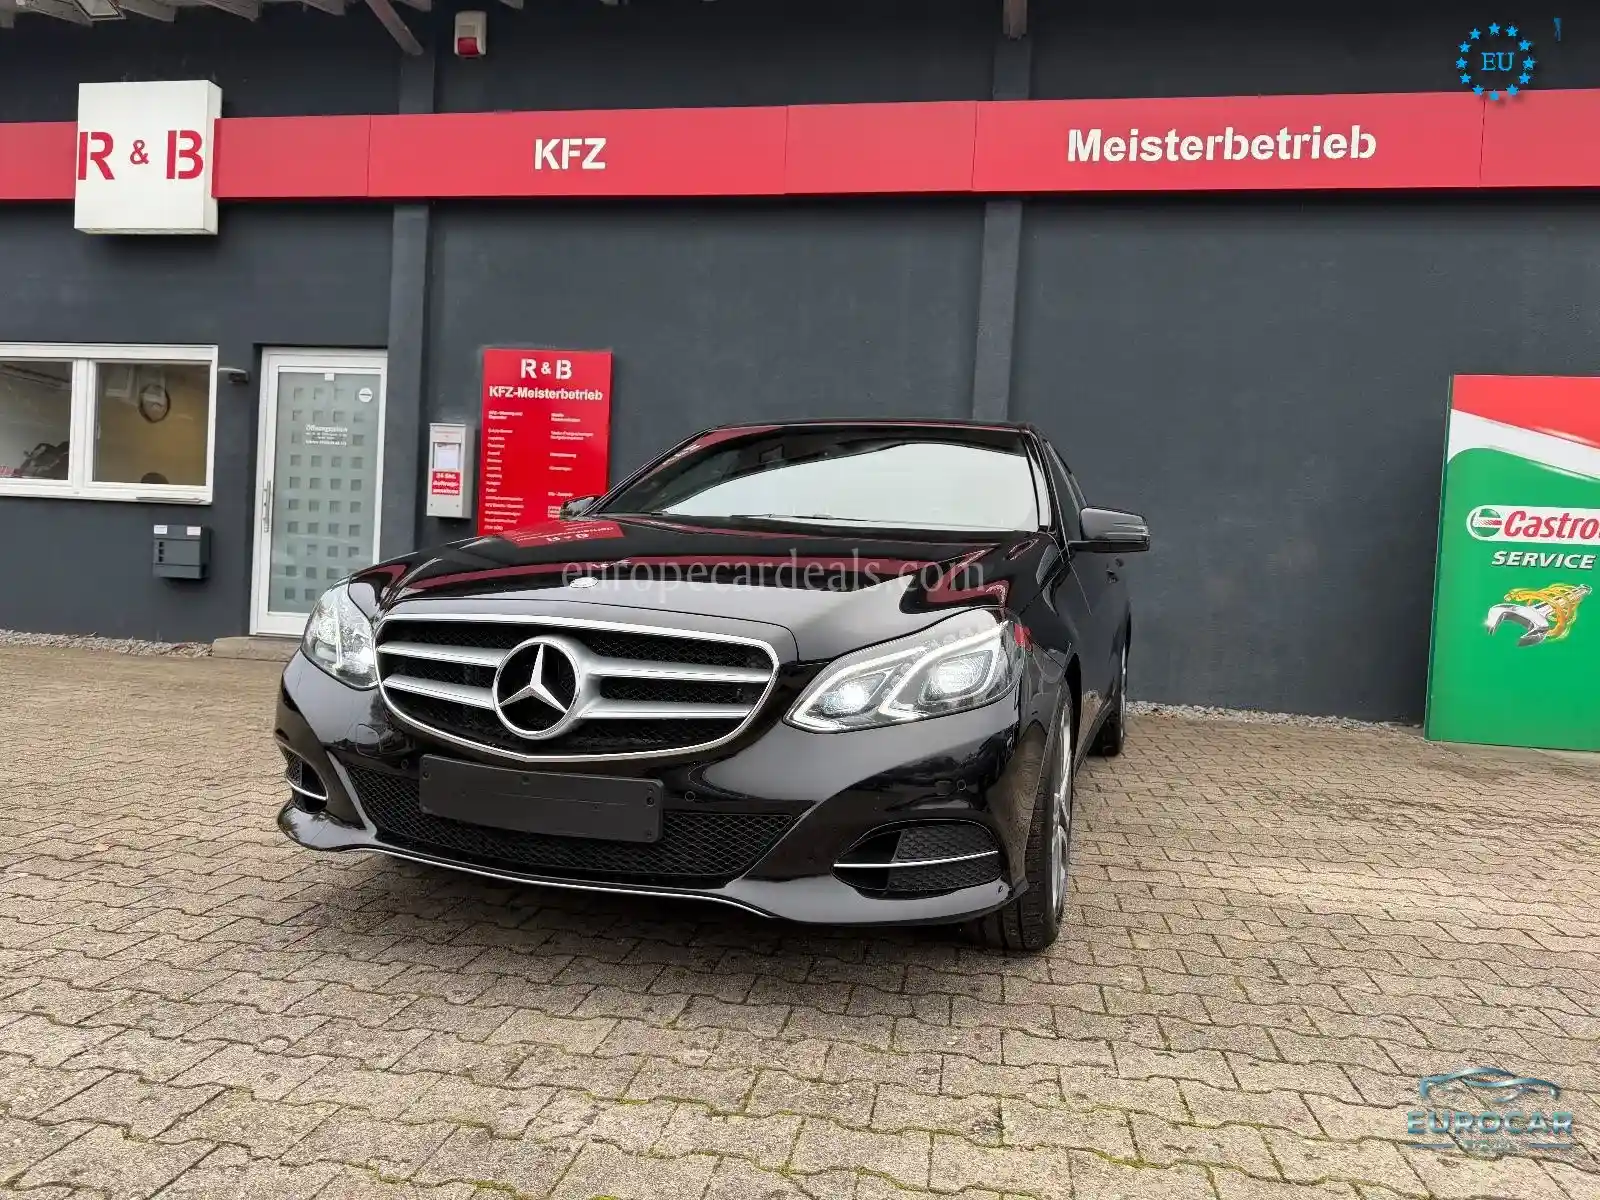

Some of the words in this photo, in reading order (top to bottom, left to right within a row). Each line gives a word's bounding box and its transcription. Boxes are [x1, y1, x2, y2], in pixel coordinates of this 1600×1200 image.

[77, 131, 116, 181] R
[130, 139, 149, 165] &
[166, 130, 204, 180] B
[534, 137, 607, 170] KFZ
[1067, 125, 1377, 163] Meisterbetrieb
[520, 358, 538, 379] R
[540, 361, 552, 375] &
[555, 359, 573, 380] B
[488, 385, 604, 401] KFZ-Meisterbetrieb
[1504, 510, 1600, 540] Castro
[1491, 550, 1596, 569] SERVICE
